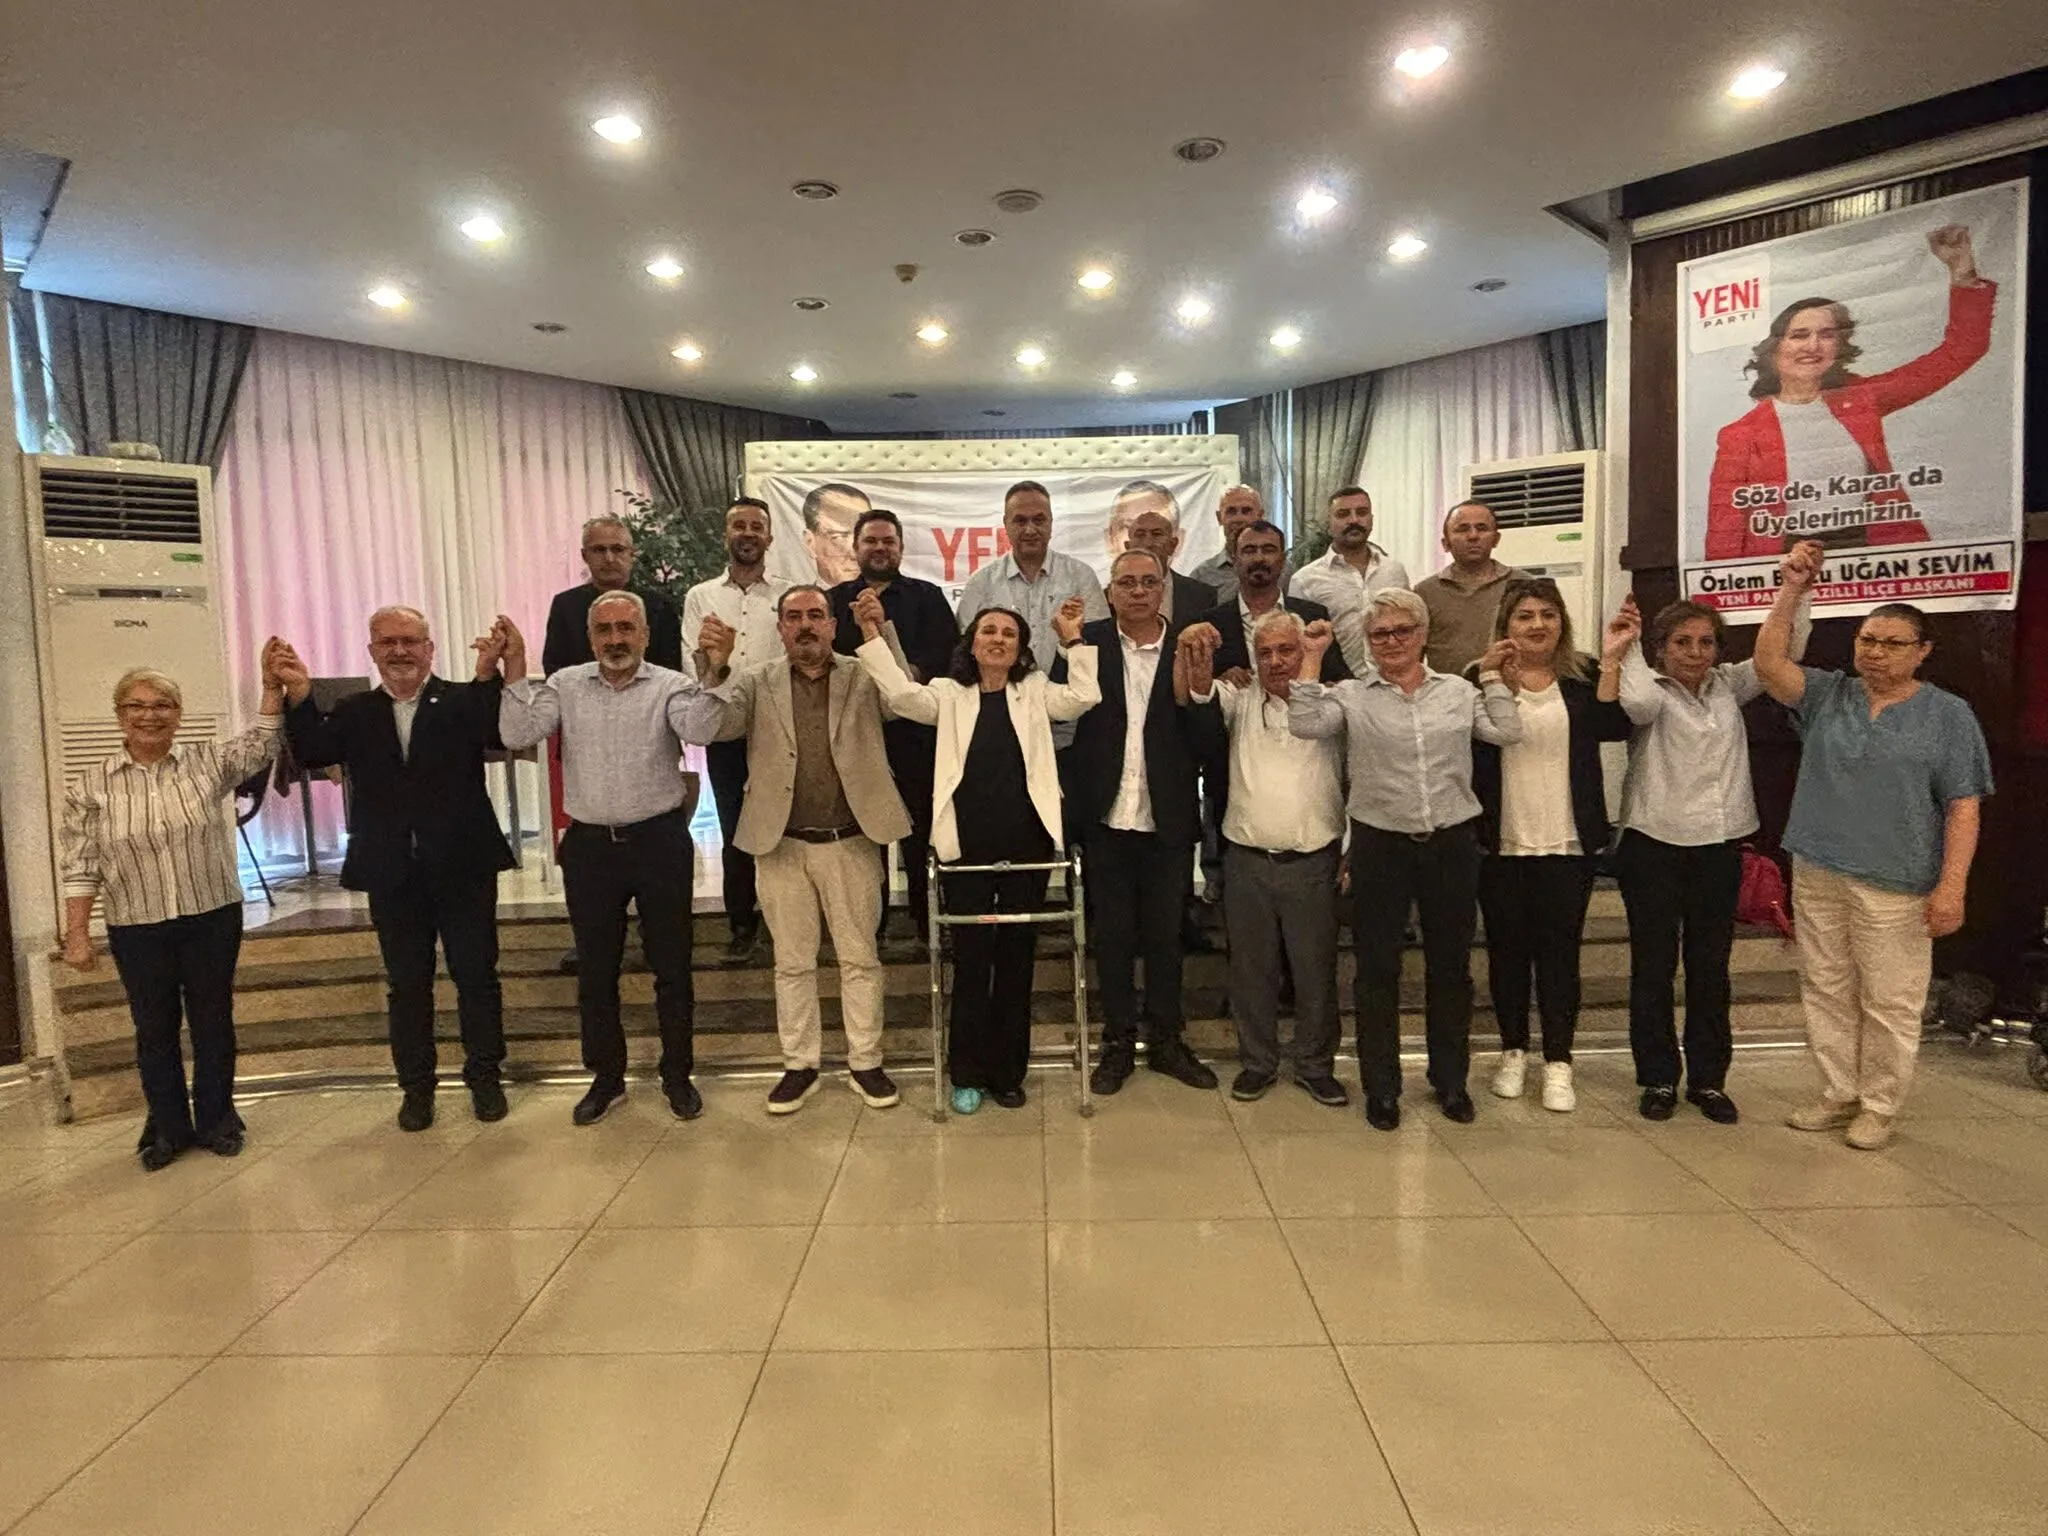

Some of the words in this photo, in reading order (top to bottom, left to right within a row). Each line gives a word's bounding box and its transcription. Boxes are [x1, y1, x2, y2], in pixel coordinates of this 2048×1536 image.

[1734, 487, 1777, 506] Söz
[1785, 482, 1821, 501] de,
[1828, 474, 1900, 496] Karar
[1908, 466, 1943, 486] da
[1752, 502, 1921, 534] Üyelerimizin.
[1701, 570, 1765, 592] Özlem
[1841, 558, 1909, 581] UĞAN
[1918, 549, 1994, 576] SEVİM
